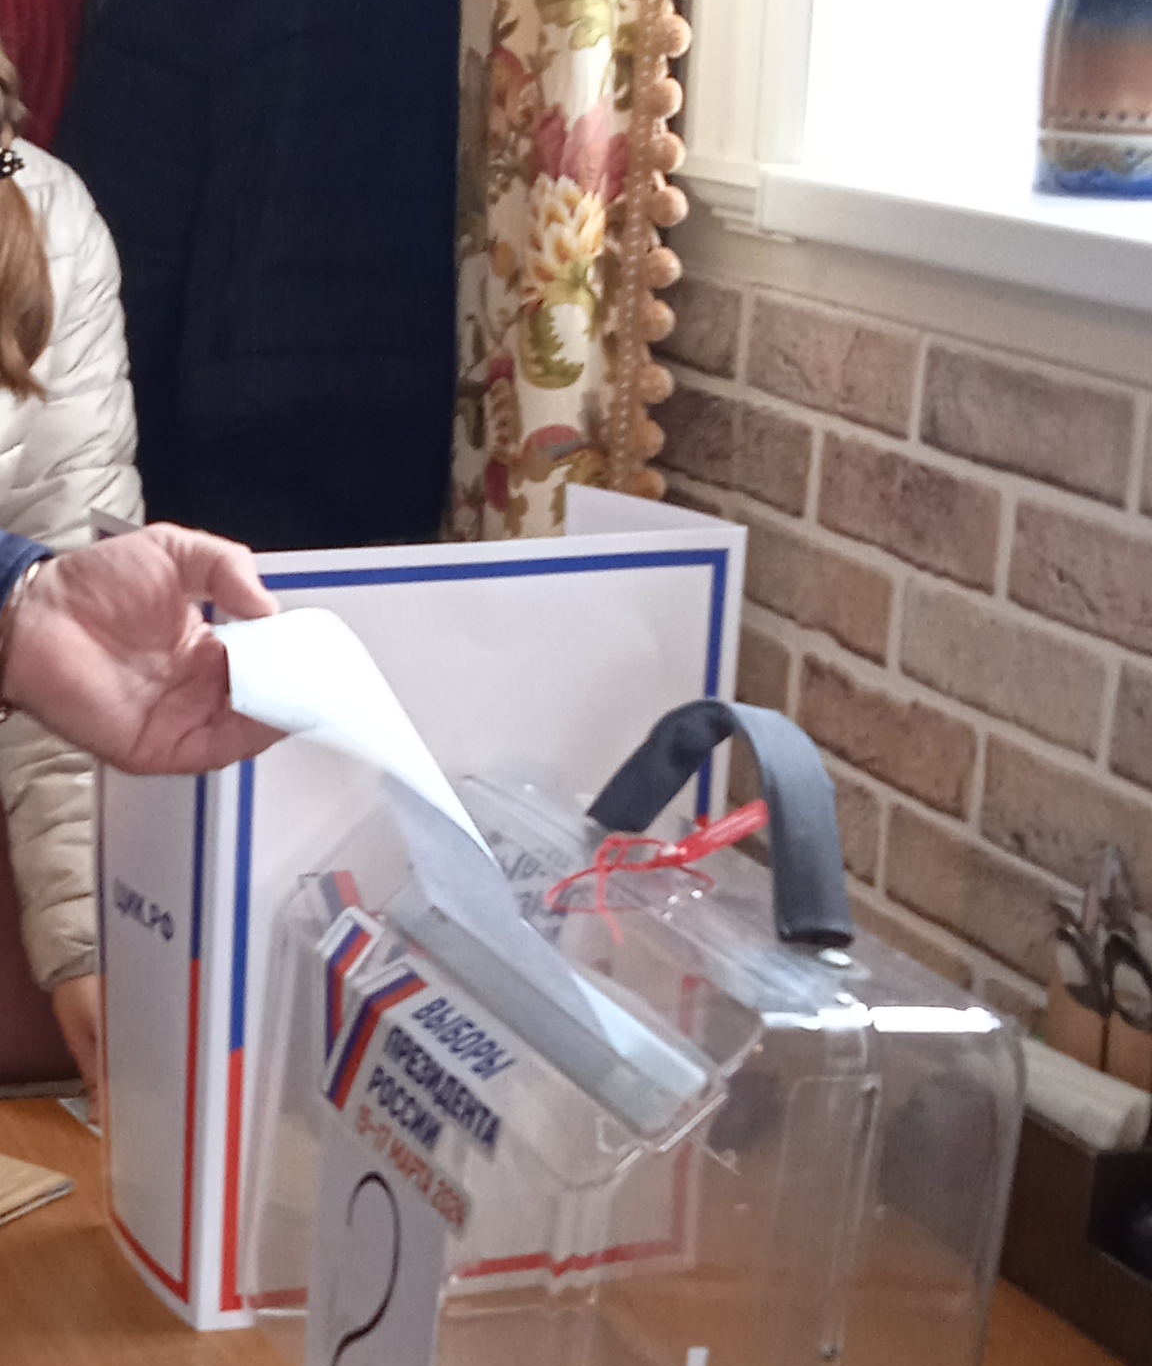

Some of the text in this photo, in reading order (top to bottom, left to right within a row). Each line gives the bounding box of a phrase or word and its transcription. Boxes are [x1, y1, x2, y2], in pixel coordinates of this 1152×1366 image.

[412, 996, 517, 1081] ВЫБОРЫ
[367, 1065, 443, 1151] РОССИИ
[384, 1025, 502, 1151] ПРЕЗИДЕНТА
